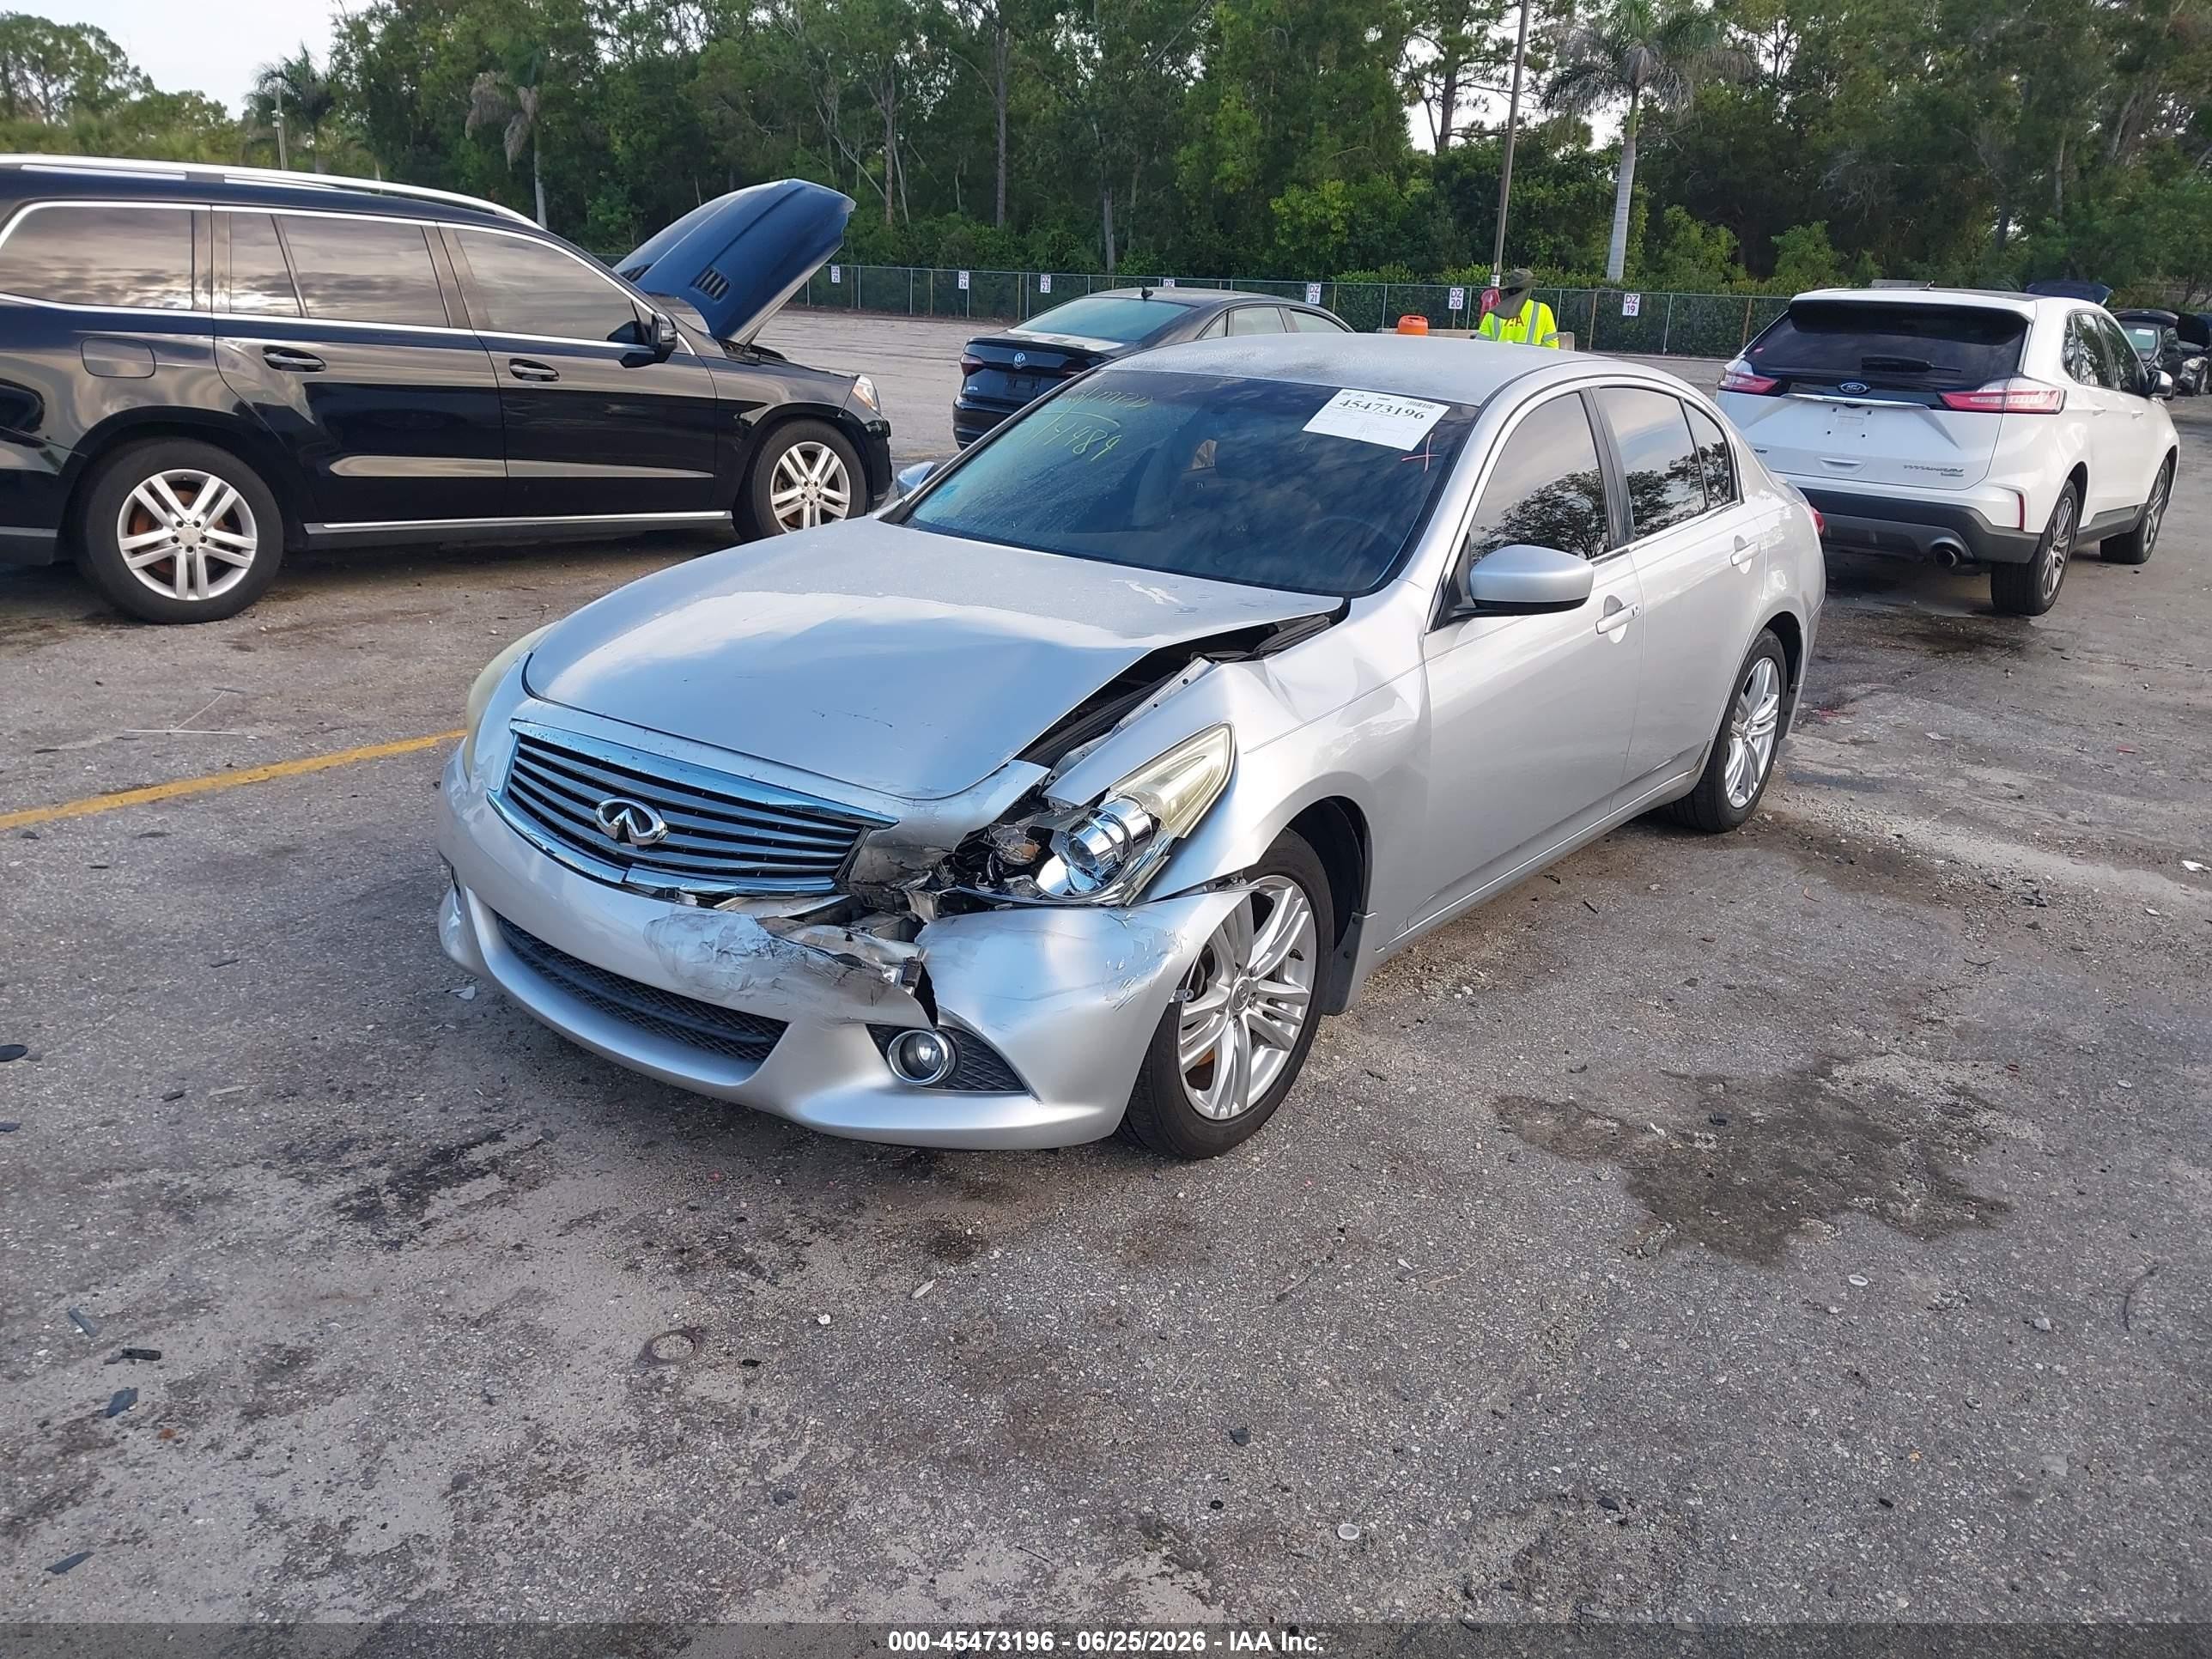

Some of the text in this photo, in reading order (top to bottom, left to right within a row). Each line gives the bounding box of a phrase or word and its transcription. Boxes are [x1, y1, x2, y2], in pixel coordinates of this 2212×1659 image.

[1310, 284, 1320, 294] DZ
[1451, 289, 1462, 298] DZ
[1310, 294, 1318, 302] 21
[1626, 295, 1638, 304] DZ
[1450, 299, 1462, 307] 20
[1626, 305, 1635, 314] 19
[1339, 395, 1425, 420] 45473196
